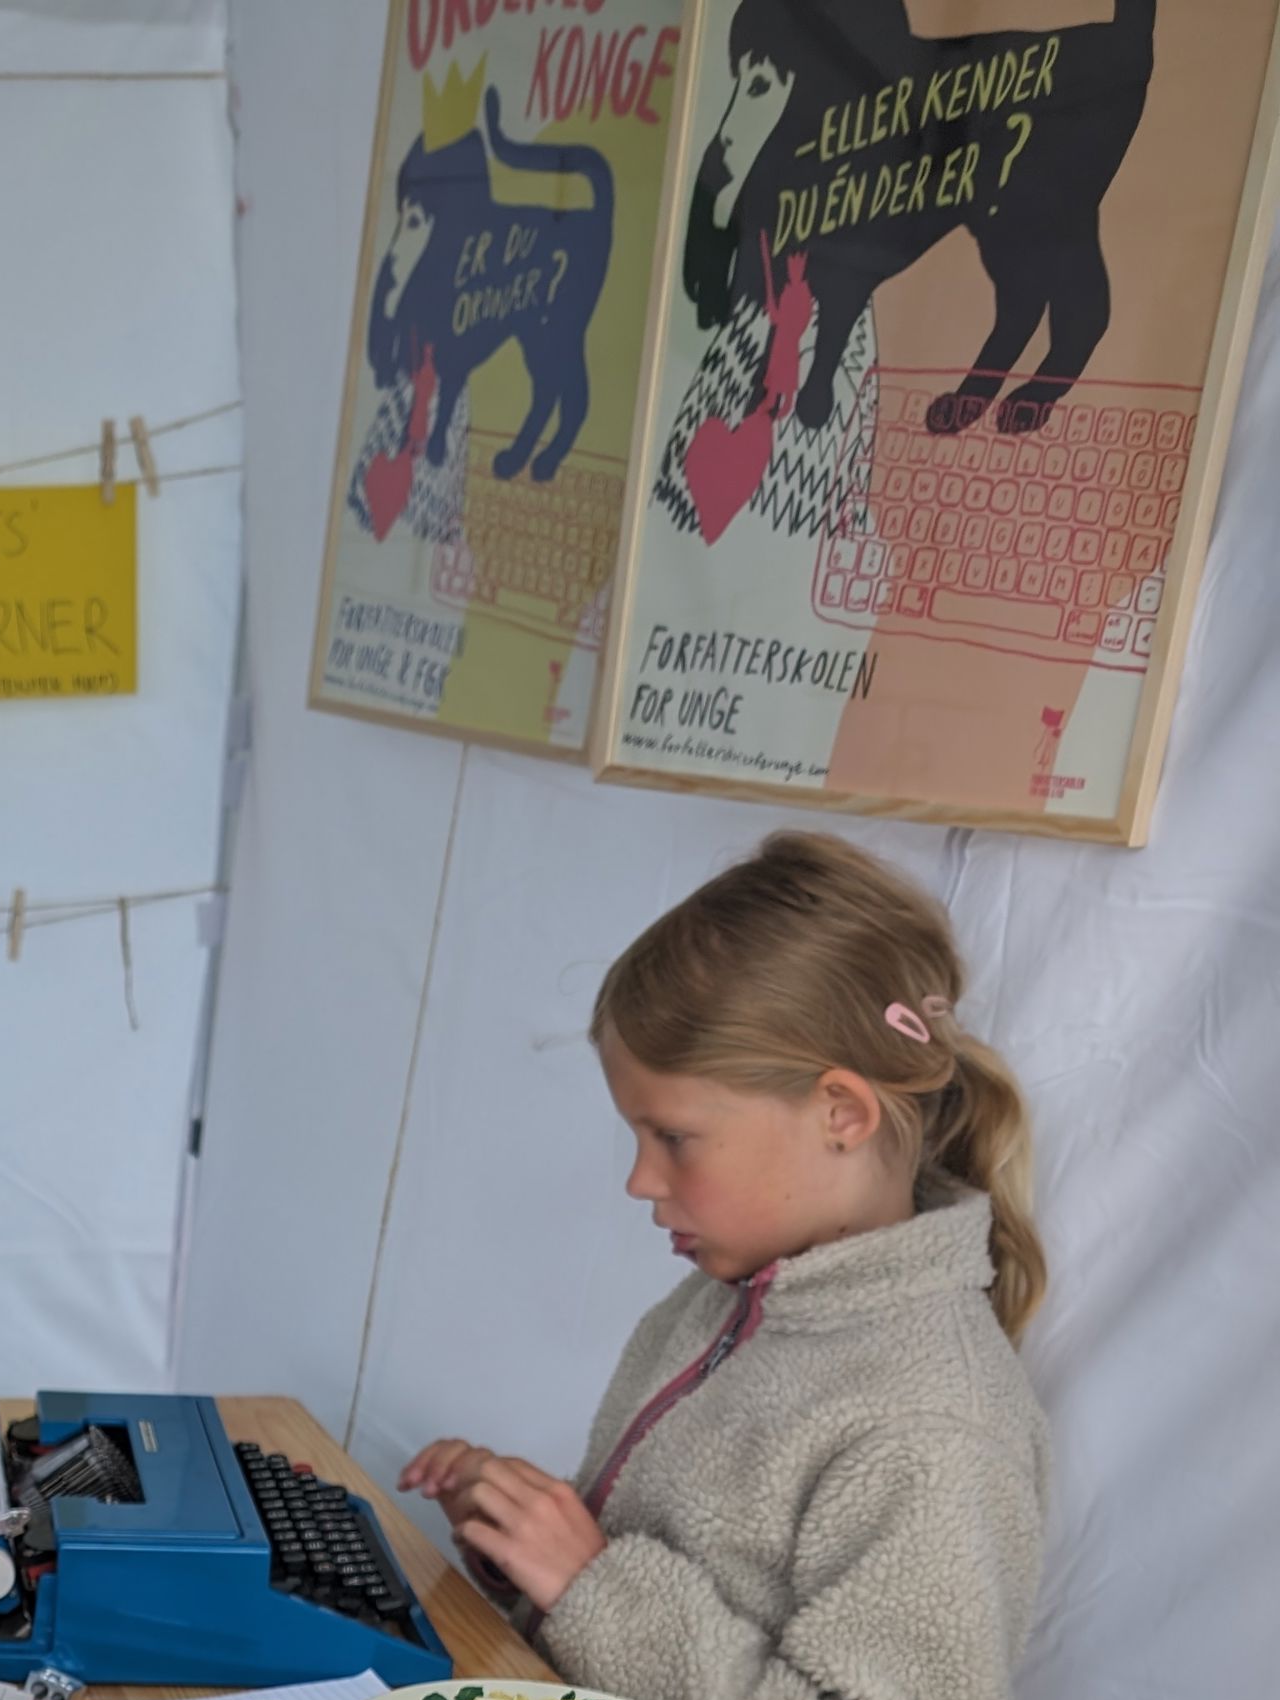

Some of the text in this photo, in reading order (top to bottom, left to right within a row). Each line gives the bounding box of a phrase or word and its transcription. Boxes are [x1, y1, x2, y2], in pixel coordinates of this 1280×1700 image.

[525, 24, 681, 125] KONGE
[920, 36, 1060, 129] KENDER
[772, 184, 818, 257] DU
[819, 161, 868, 235] ÉN
[869, 154, 933, 221] DER
[936, 141, 980, 207] ER
[454, 223, 538, 288] ER DU
[640, 623, 878, 700] FORFATTERSKOLEN
[630, 683, 744, 735] FOR UNGE
